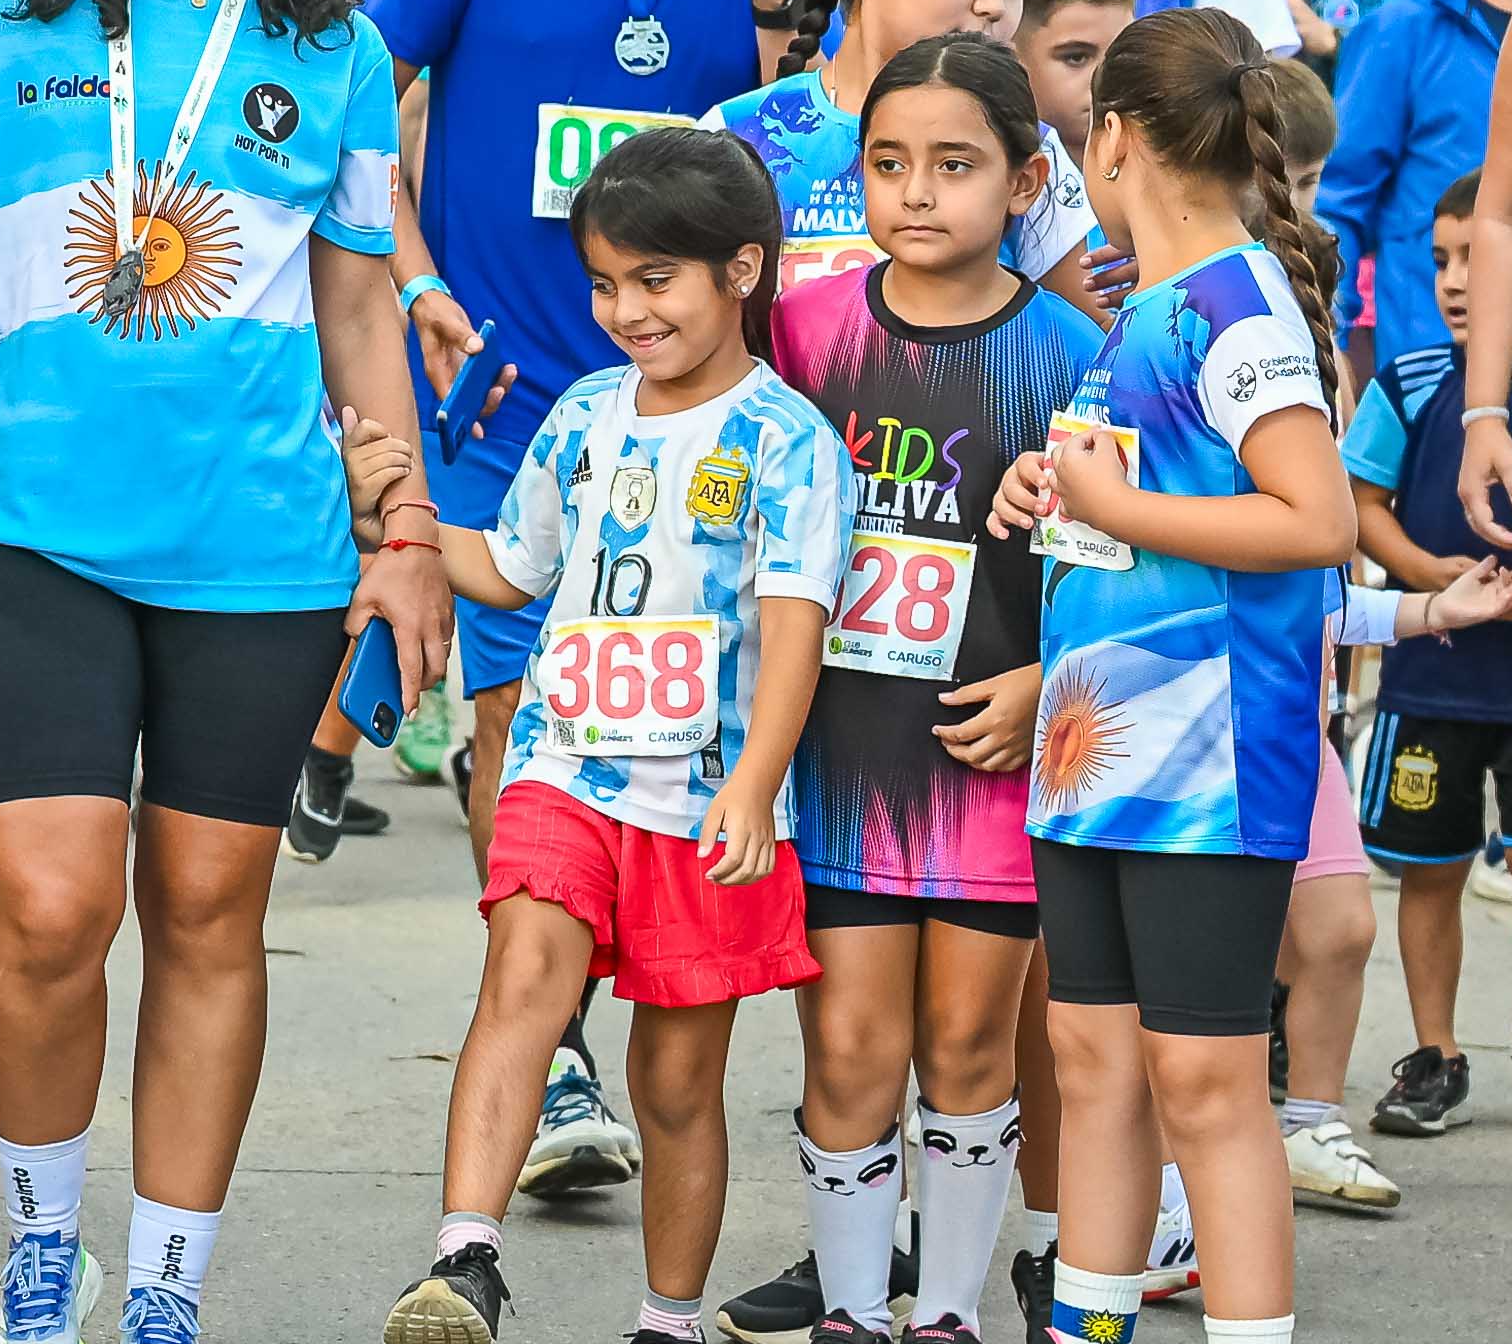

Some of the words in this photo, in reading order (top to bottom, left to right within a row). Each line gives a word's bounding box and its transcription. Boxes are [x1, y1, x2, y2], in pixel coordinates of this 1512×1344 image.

[16, 80, 38, 106] la
[234, 134, 258, 154] HOY
[258, 142, 281, 161] POR
[281, 154, 291, 170] TI
[792, 207, 867, 233] MALV
[844, 410, 969, 492] KIDS
[697, 476, 731, 506] AFA
[591, 552, 652, 617] 10
[827, 545, 956, 642] 28
[887, 649, 943, 667] CARUSO
[547, 631, 705, 720] 368
[648, 730, 703, 743] CARUSO
